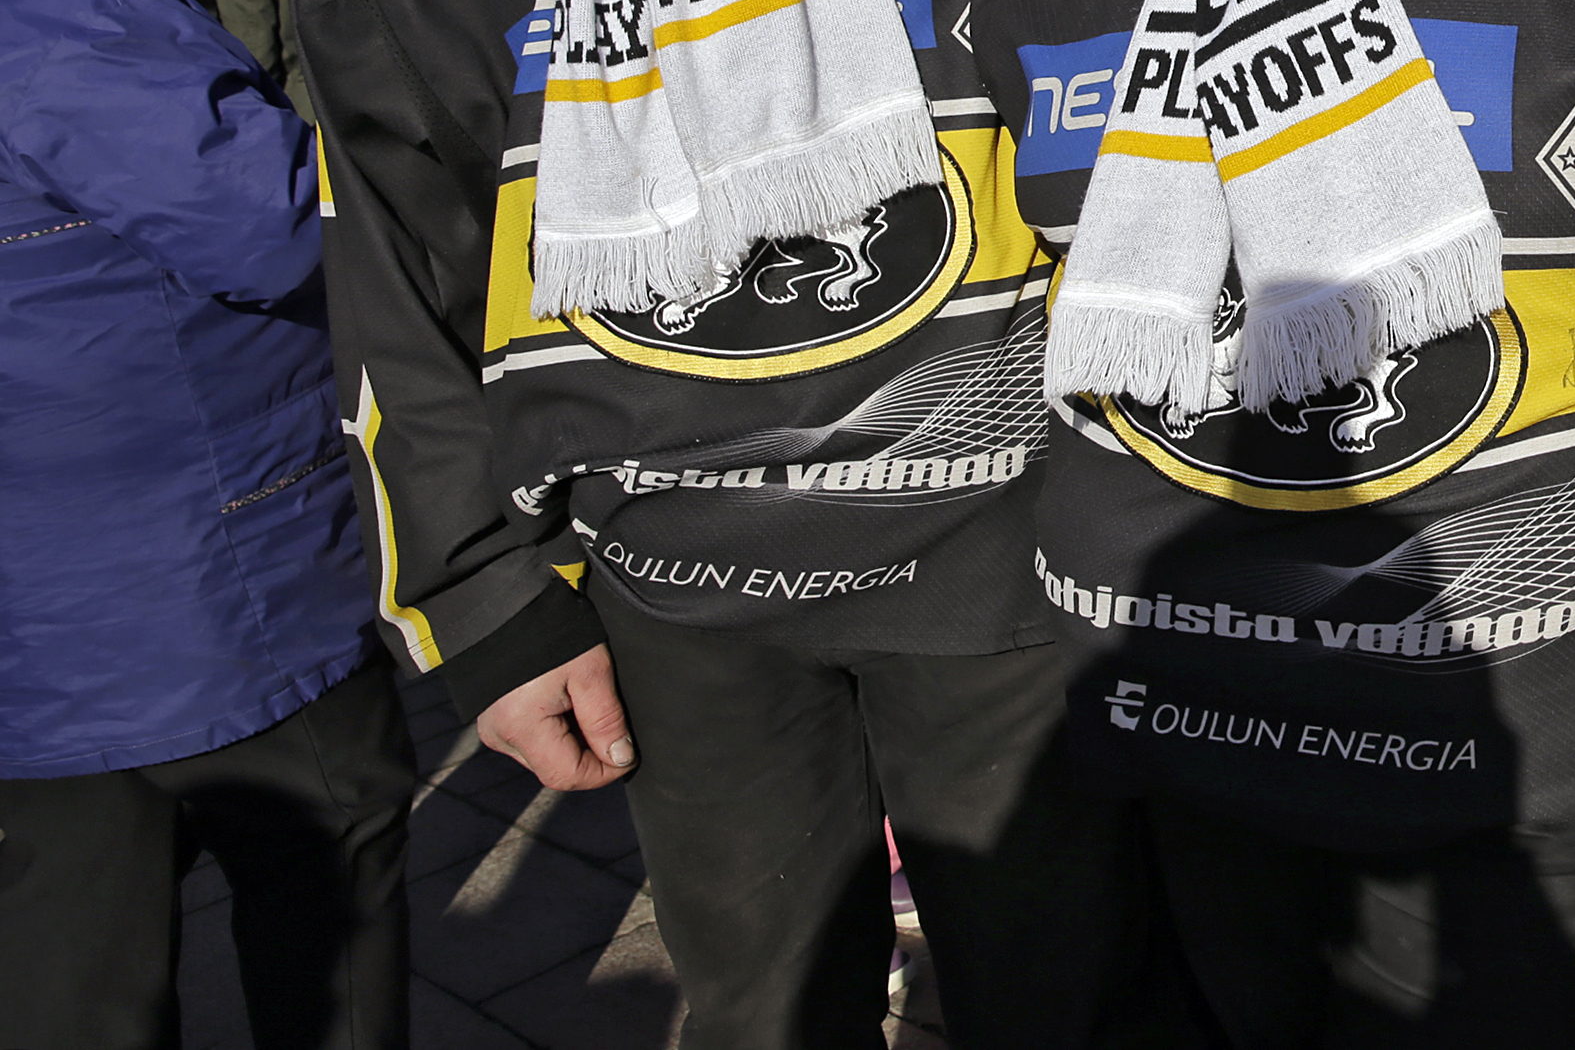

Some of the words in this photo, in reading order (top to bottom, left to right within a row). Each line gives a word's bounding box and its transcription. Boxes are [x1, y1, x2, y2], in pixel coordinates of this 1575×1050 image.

[603, 542, 736, 589] OULUN
[741, 560, 918, 600] ENERGIA
[1151, 703, 1288, 750] OULUN
[1297, 724, 1478, 772] ENERGIA
